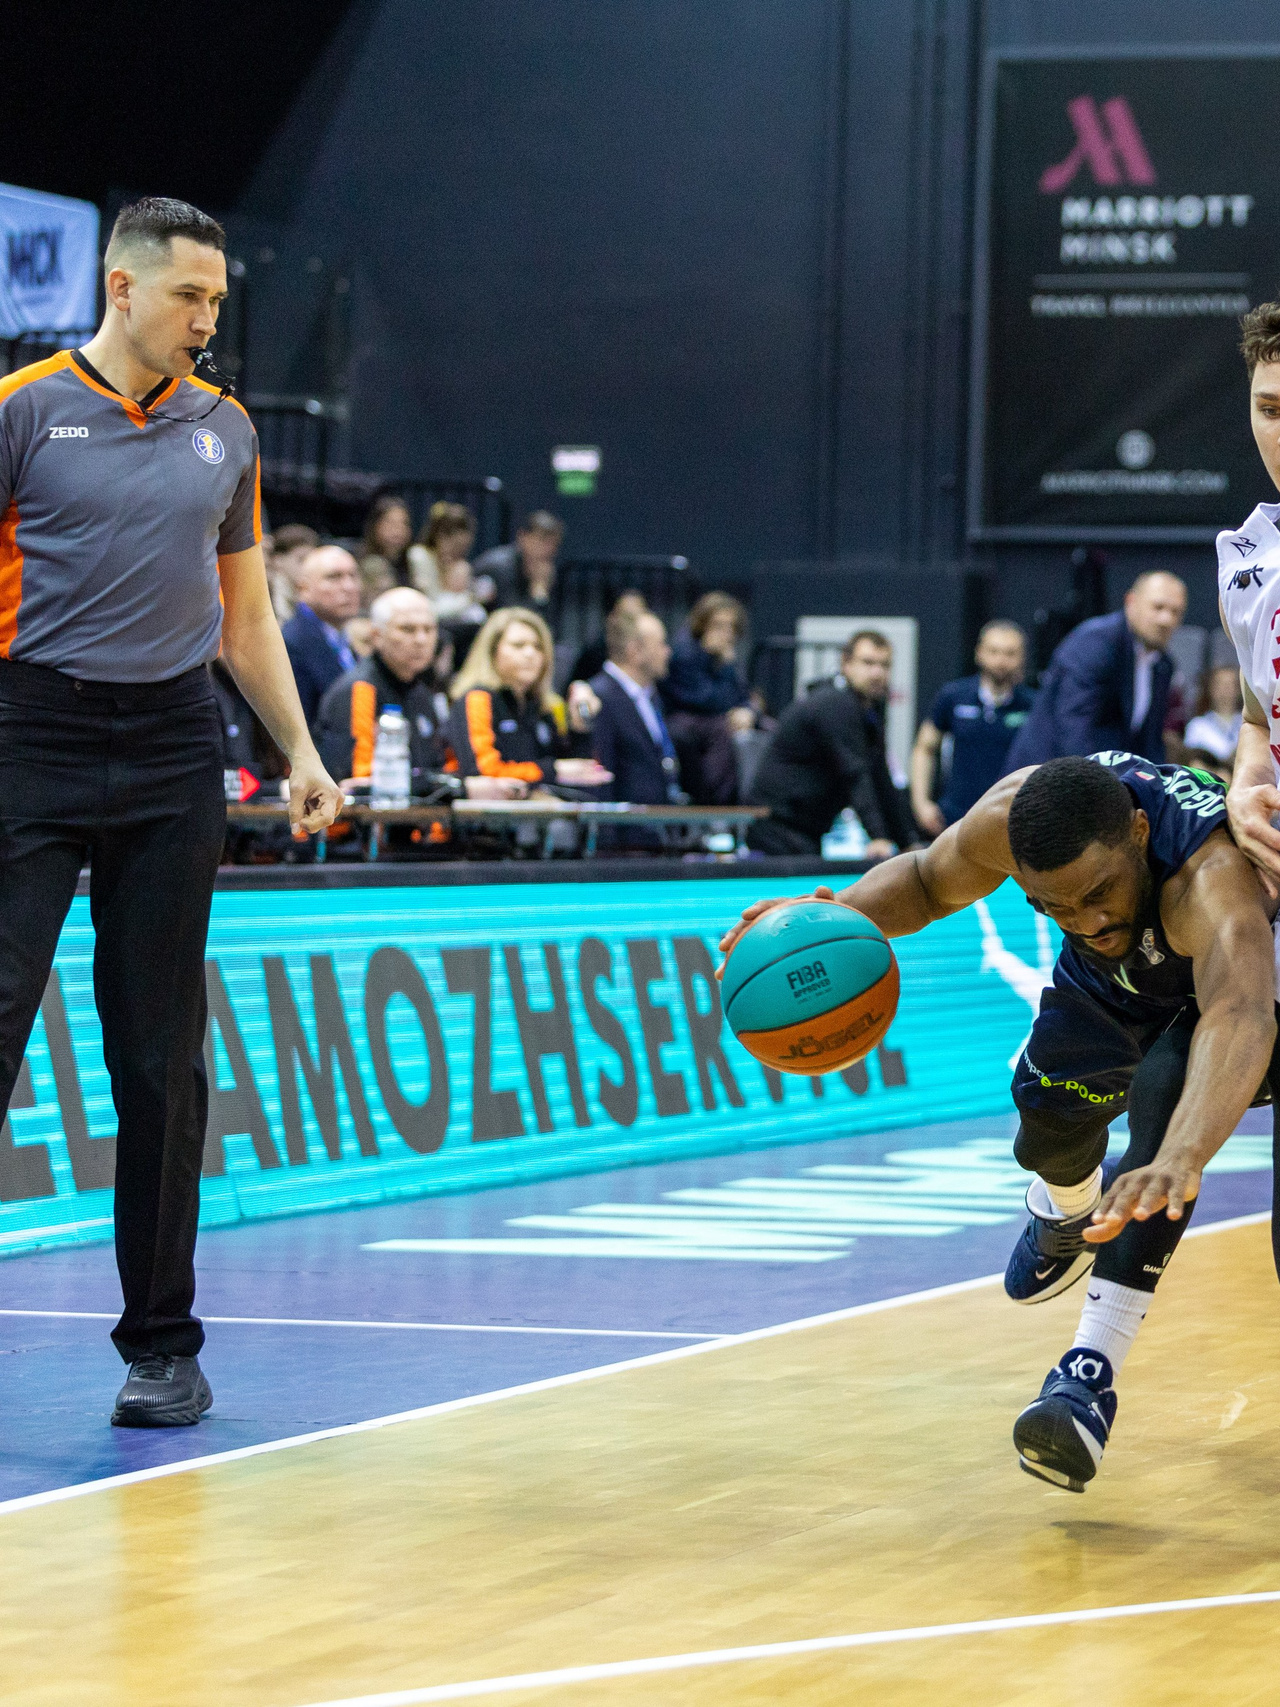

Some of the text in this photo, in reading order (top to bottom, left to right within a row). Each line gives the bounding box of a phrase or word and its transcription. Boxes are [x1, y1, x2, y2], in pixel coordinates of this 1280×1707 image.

[1061, 195, 1253, 229] MARRIOTT
[1059, 230, 1177, 264] MINSK
[49, 426, 89, 439] ZEDO
[786, 960, 828, 990] FIBA
